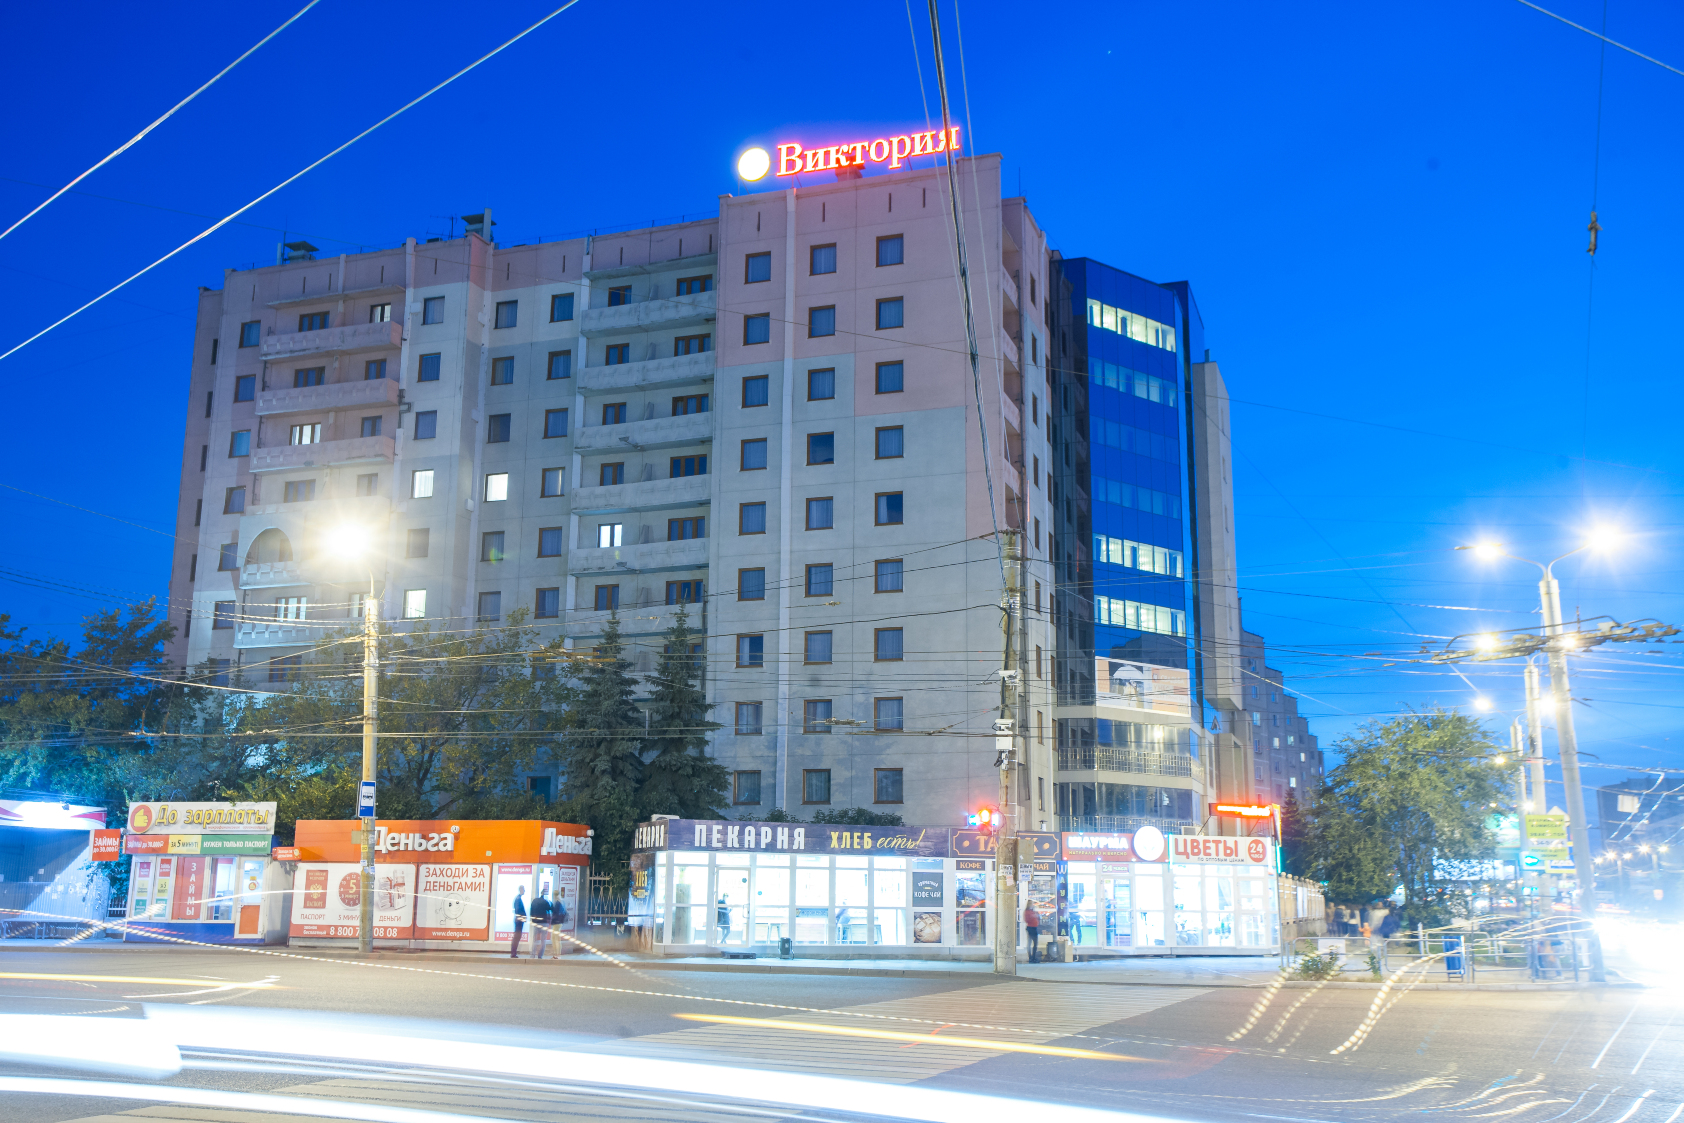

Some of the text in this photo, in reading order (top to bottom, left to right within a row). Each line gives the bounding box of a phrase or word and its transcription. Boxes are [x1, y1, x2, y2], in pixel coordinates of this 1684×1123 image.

[777, 127, 959, 176] Виктория
[155, 804, 269, 829] До зарплаты
[94, 837, 119, 847] ЗАЙМЫ
[374, 826, 455, 854] Деньга
[541, 828, 592, 856] Деньга
[694, 824, 926, 850] ПЕКАРНЯ ХЛЕБ есть!
[1067, 836, 1129, 849] ШАУРМА
[177, 839, 182, 847] 5
[244, 840, 268, 848] ПАСПОРТ
[1174, 837, 1239, 860] ЦВЕТЫ
[1250, 843, 1263, 853] 24
[960, 861, 982, 869] КОФЕ
[1033, 862, 1049, 870] ЧАЙ
[1102, 864, 1112, 872] 24
[424, 867, 485, 879] ЗАХОДИ ЗА
[635, 870, 648, 887] ХЛЕБ
[348, 879, 357, 894] 5
[423, 881, 485, 892] ДЕНЬГАМИ!
[329, 926, 335, 936] 8
[337, 926, 354, 937] 800
[373, 927, 384, 937] 08
[386, 928, 398, 937] 08
[431, 930, 470, 938] www.denga.ru
